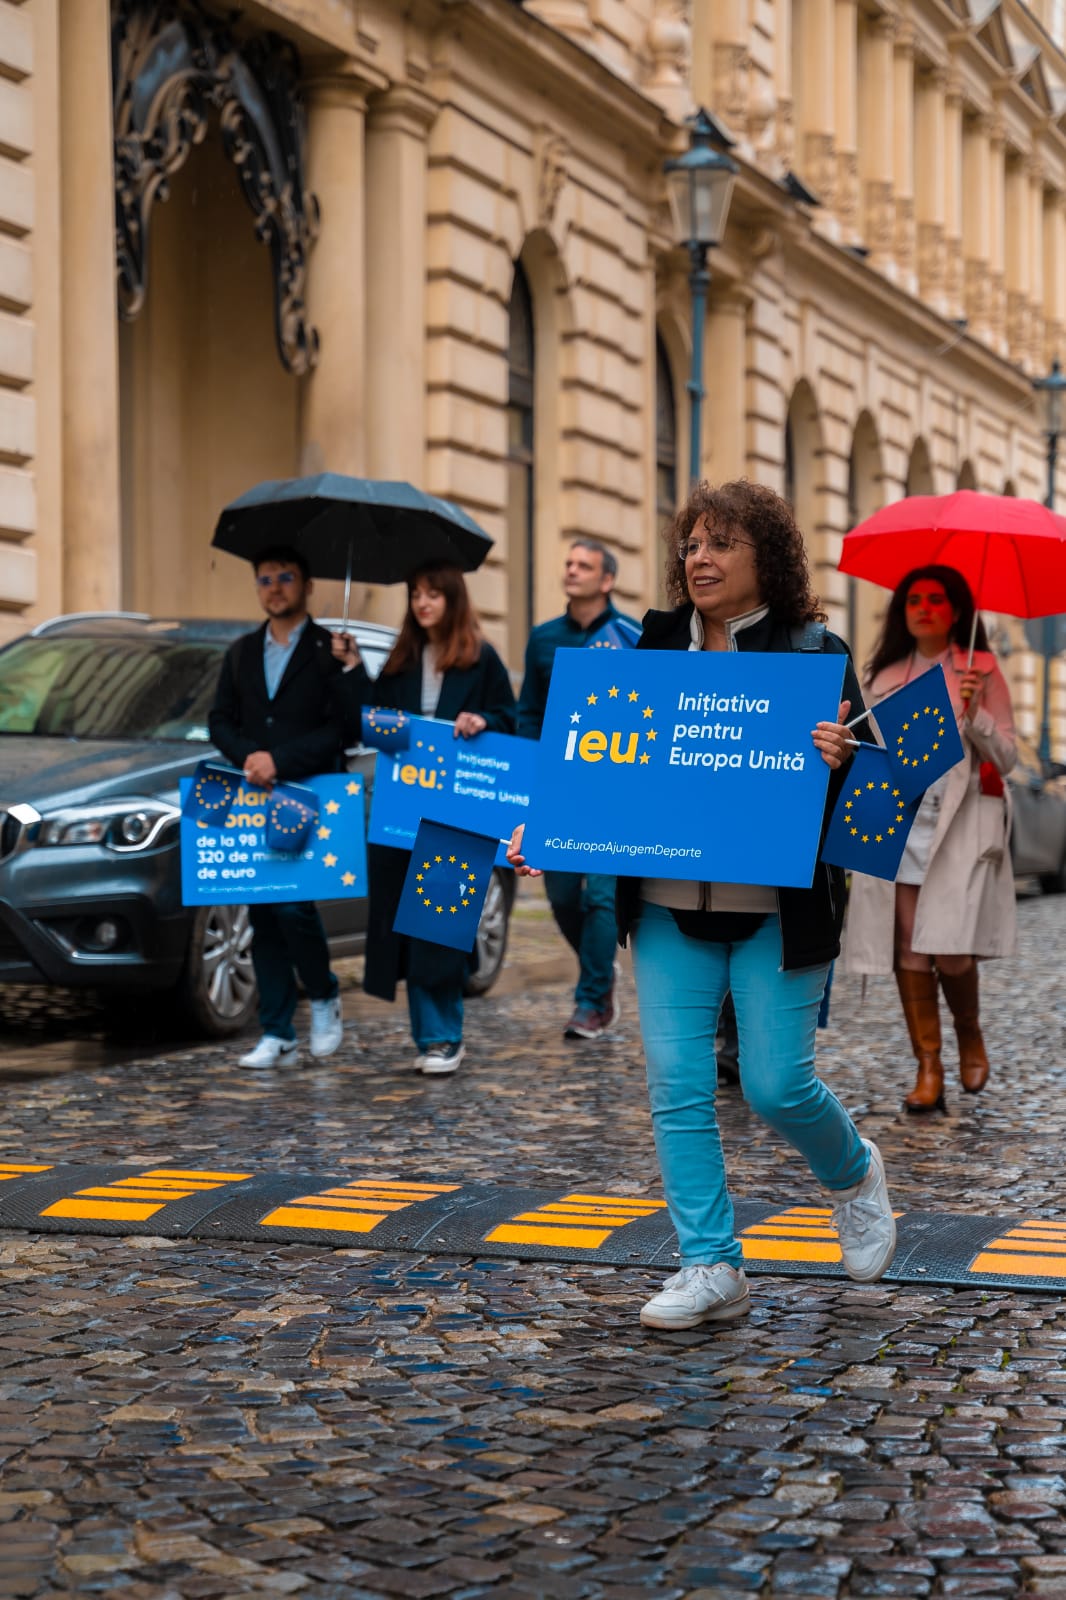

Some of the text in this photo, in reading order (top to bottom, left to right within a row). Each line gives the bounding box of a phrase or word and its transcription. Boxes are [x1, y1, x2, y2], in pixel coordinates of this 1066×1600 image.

[678, 692, 770, 718] Inițiativa
[672, 723, 743, 742] pentru
[669, 746, 805, 771] Europa Unită
[196, 835, 217, 848] de
[220, 834, 236, 848] la
[238, 833, 258, 848] 98
[544, 837, 703, 859] #CuEuropaAjungemDeparte
[197, 850, 226, 864] 320
[228, 850, 249, 863] de
[197, 867, 257, 880] de euro
